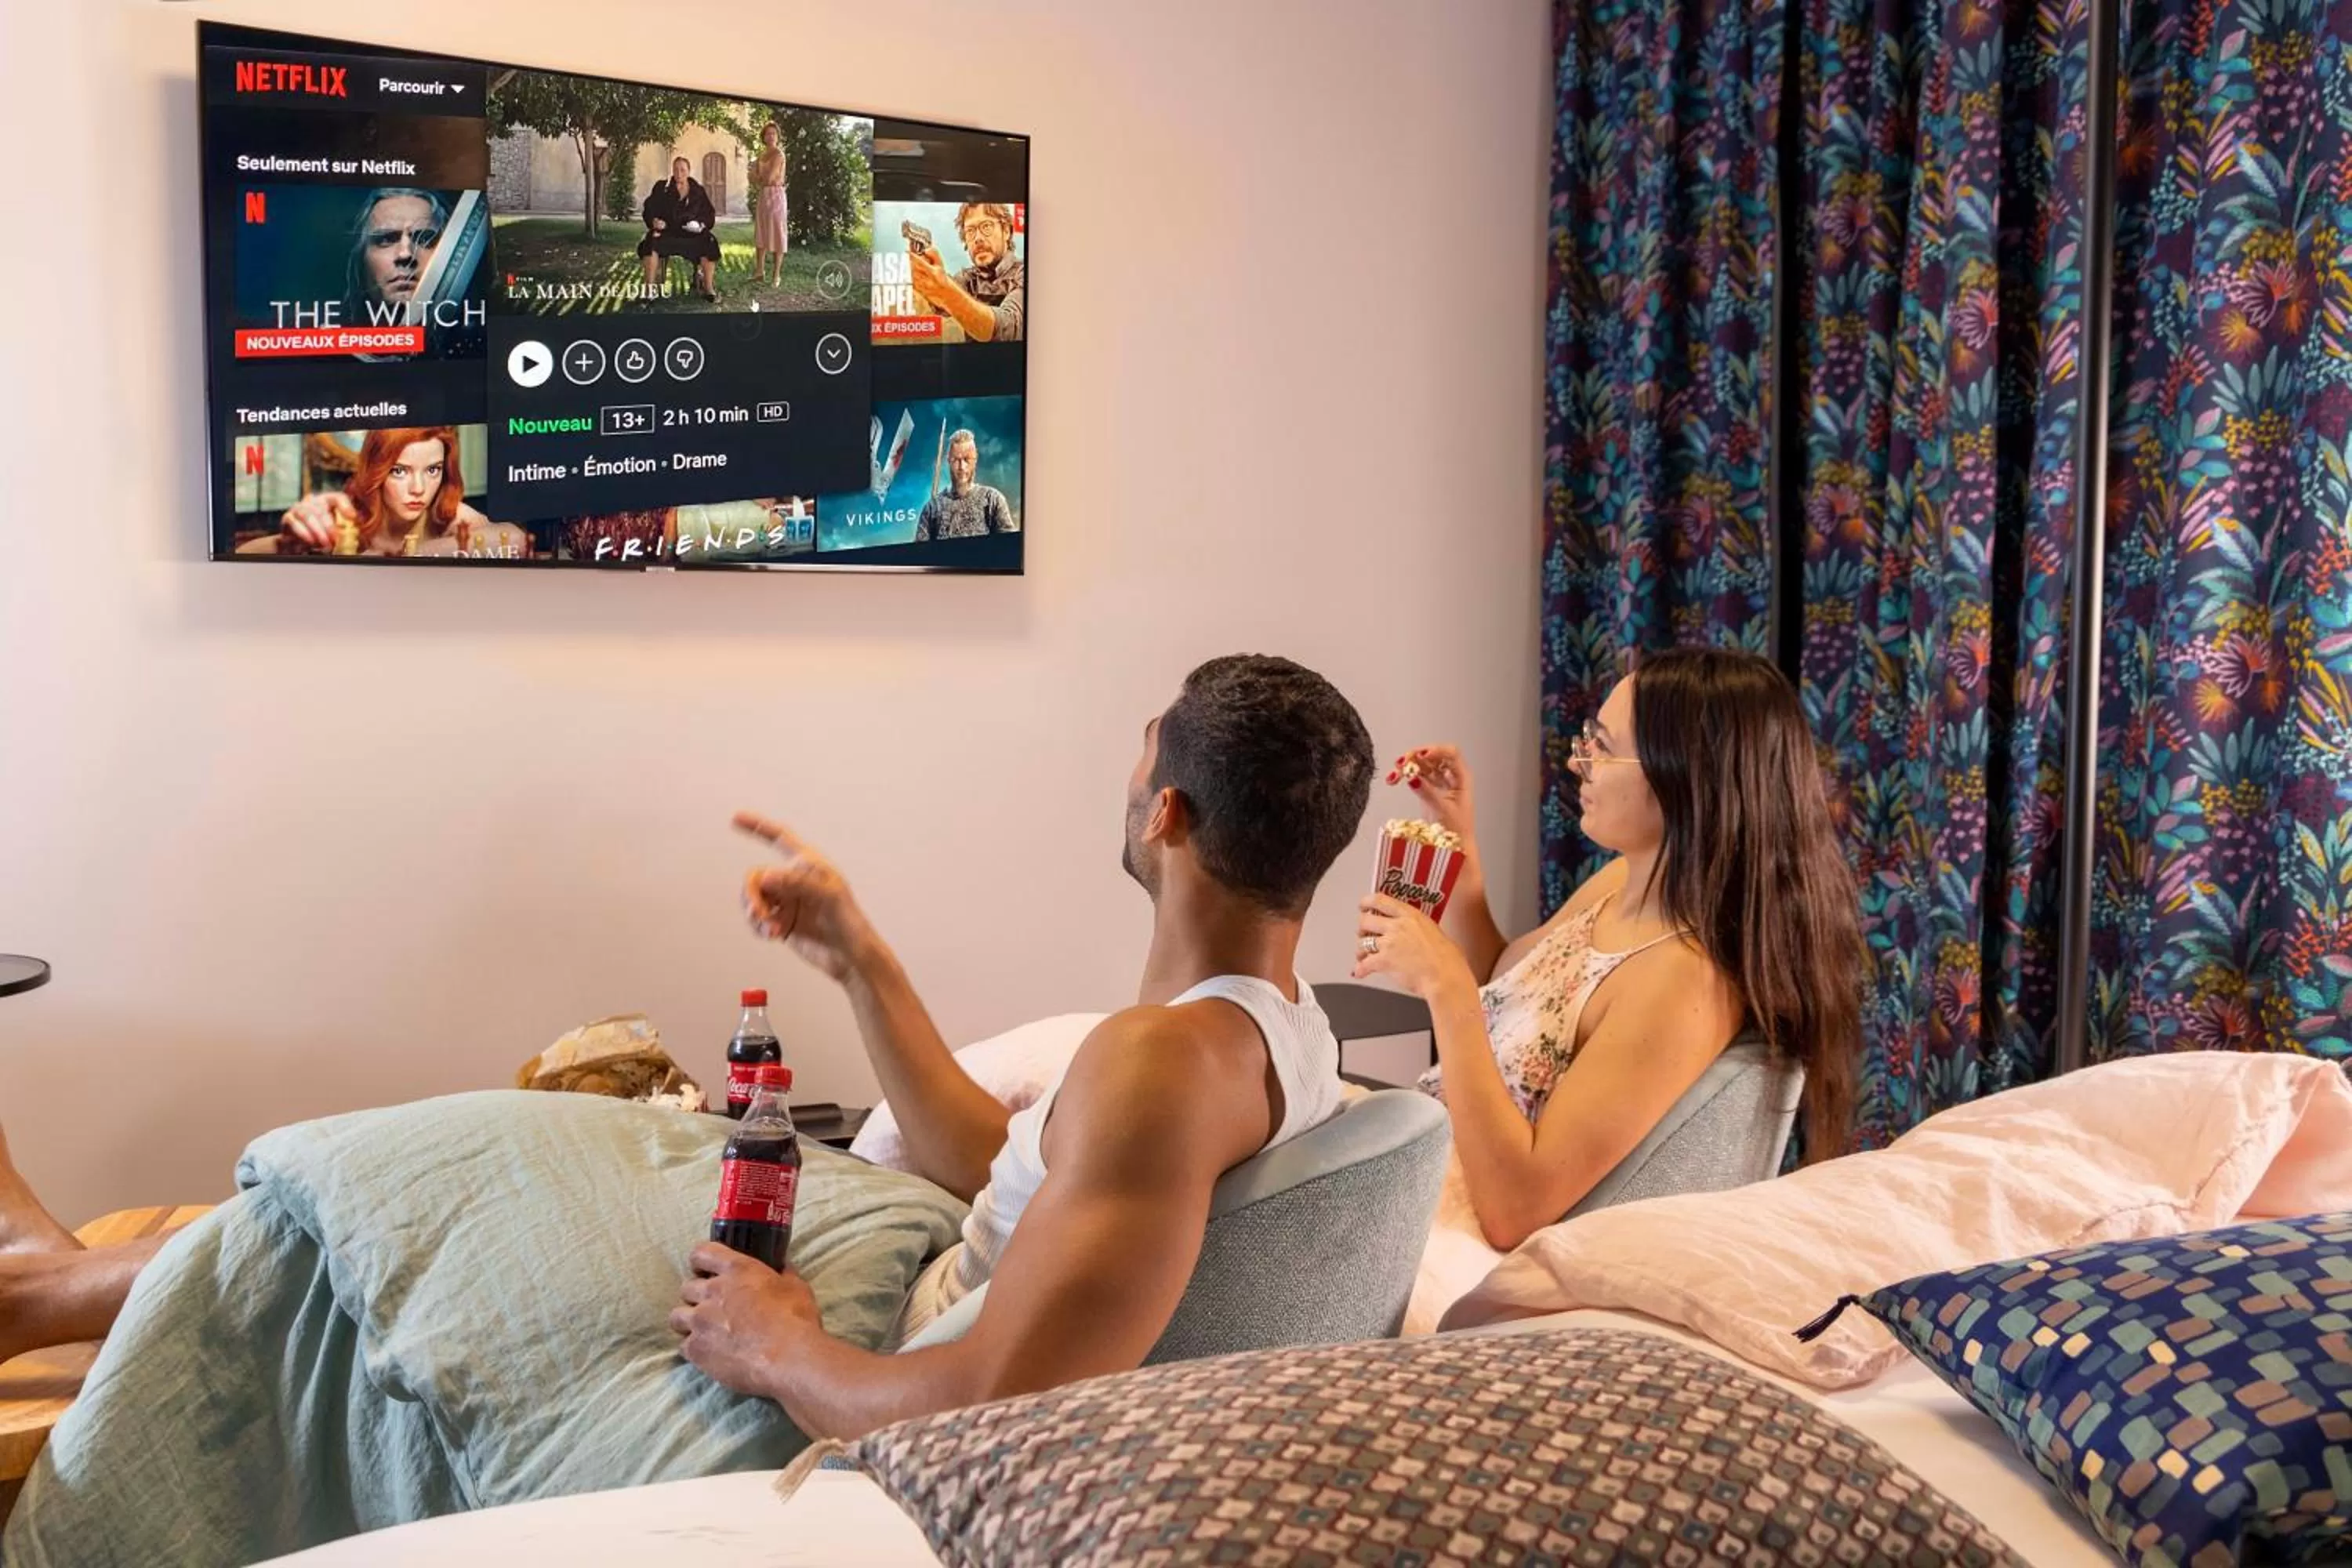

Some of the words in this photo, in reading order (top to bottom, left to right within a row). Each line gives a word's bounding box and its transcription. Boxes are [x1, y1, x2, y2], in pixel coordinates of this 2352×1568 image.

[236, 61, 347, 98] NETFLIX
[379, 78, 445, 96] Parcourir
[238, 155, 328, 172] Seulement
[332, 160, 358, 174] sur
[361, 161, 416, 176] Netflix
[245, 191, 266, 223] N
[508, 286, 530, 299] LA
[537, 284, 592, 299] MAIN
[626, 283, 673, 299] DIEU
[270, 301, 341, 328] THE
[365, 299, 485, 327] WITCH
[884, 321, 935, 333] ÉPISODES
[246, 336, 334, 350] NOUVEAUX
[338, 332, 415, 348] ÉPISODES
[237, 407, 330, 424] Tendances
[334, 401, 407, 419] actuelles
[509, 417, 593, 435] Nouveau
[612, 413, 645, 429] 13+
[663, 411, 675, 425] 2
[679, 409, 689, 425] h
[694, 407, 717, 423] 10
[719, 405, 749, 422] min
[763, 405, 783, 418] HD
[245, 445, 264, 476] N
[509, 464, 566, 482] Intime
[584, 456, 656, 477] Émotion
[673, 452, 728, 470] Drame
[846, 509, 917, 526] VIKINGS
